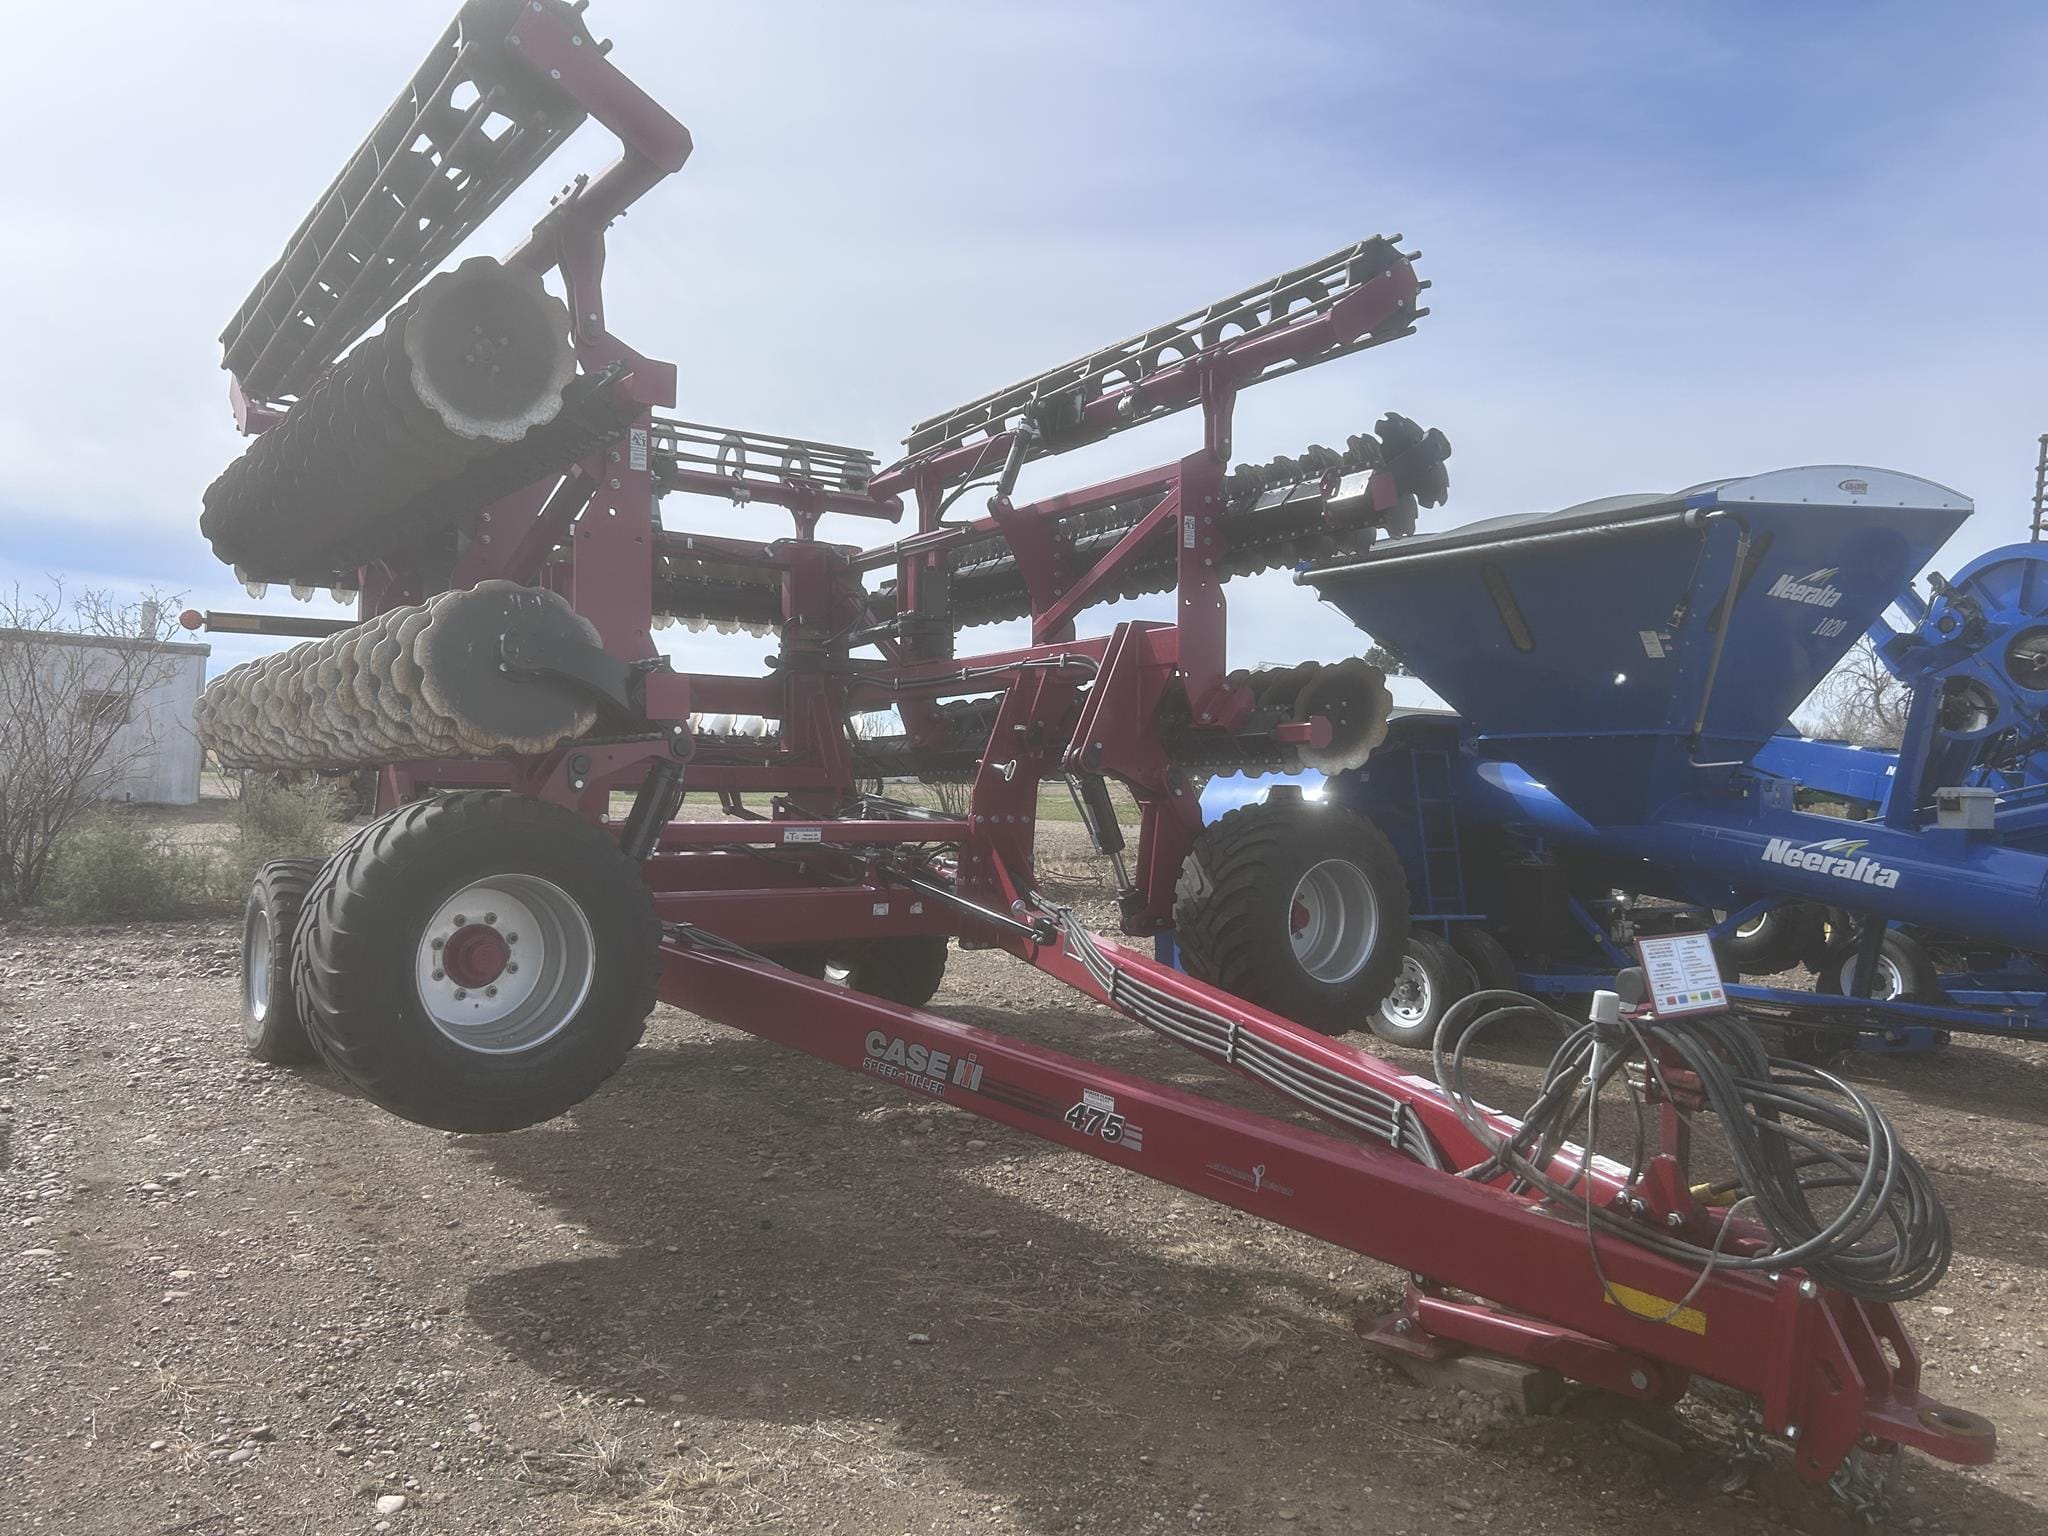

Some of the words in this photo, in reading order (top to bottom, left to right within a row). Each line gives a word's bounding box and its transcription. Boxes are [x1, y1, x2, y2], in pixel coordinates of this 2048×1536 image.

[1766, 574, 1843, 608] Neeralta
[1811, 617, 1848, 638] 1020
[1761, 838, 1901, 889] Neeralta
[865, 1030, 951, 1080] CASE
[863, 1057, 945, 1096] SPEED-TILLER
[1064, 1102, 1126, 1144] 475
